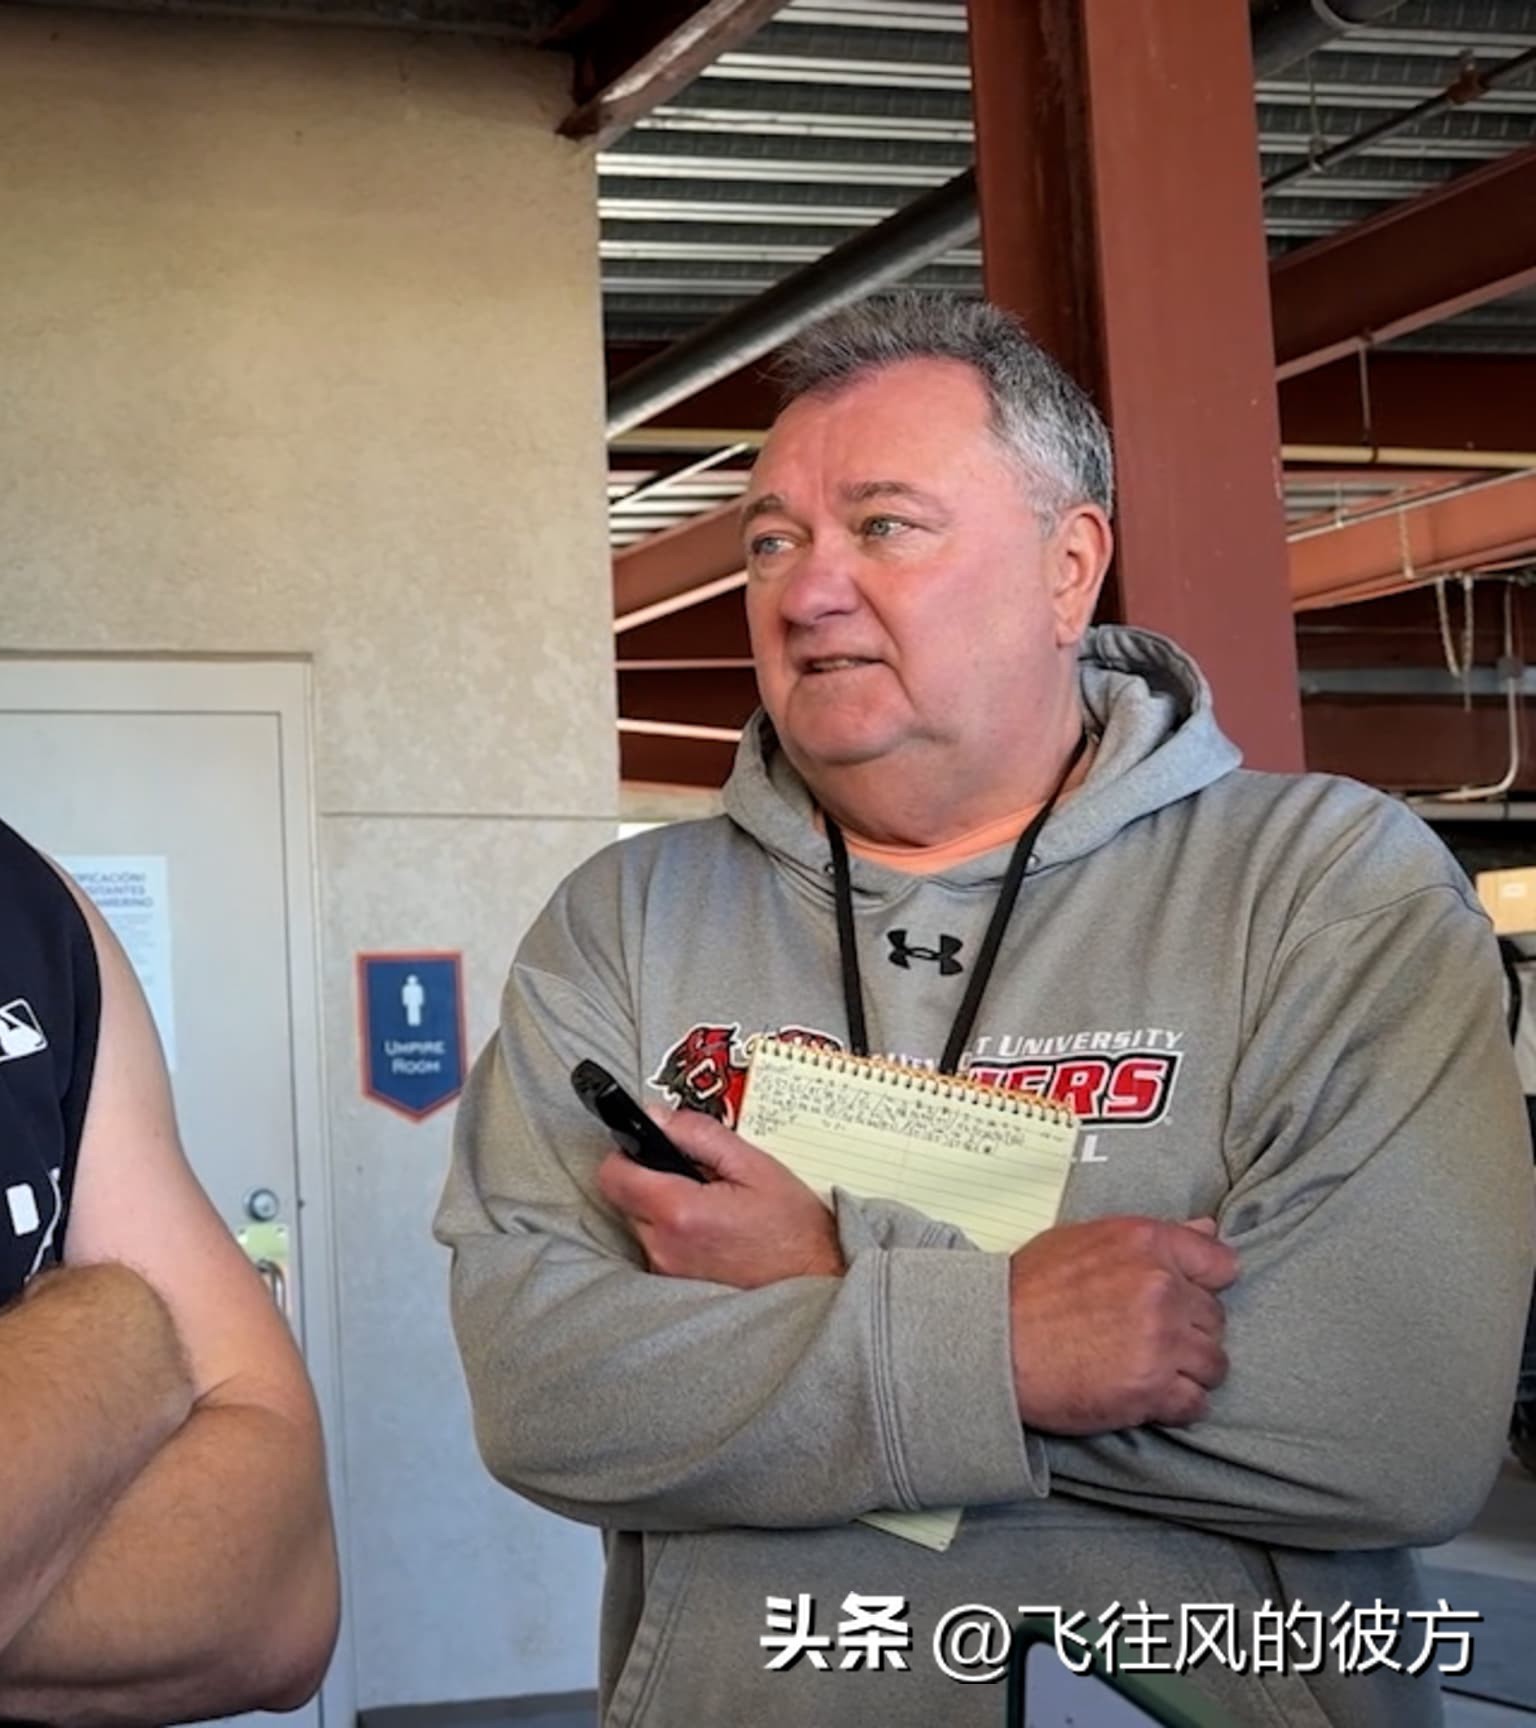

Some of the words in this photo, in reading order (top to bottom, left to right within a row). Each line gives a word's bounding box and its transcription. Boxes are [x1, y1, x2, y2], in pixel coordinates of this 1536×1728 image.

[383, 1039, 446, 1056] UMPIRE
[998, 1028, 1184, 1057] UNIVERSITY
[391, 1057, 441, 1075] ROOM
[969, 1057, 1169, 1119] ERS
